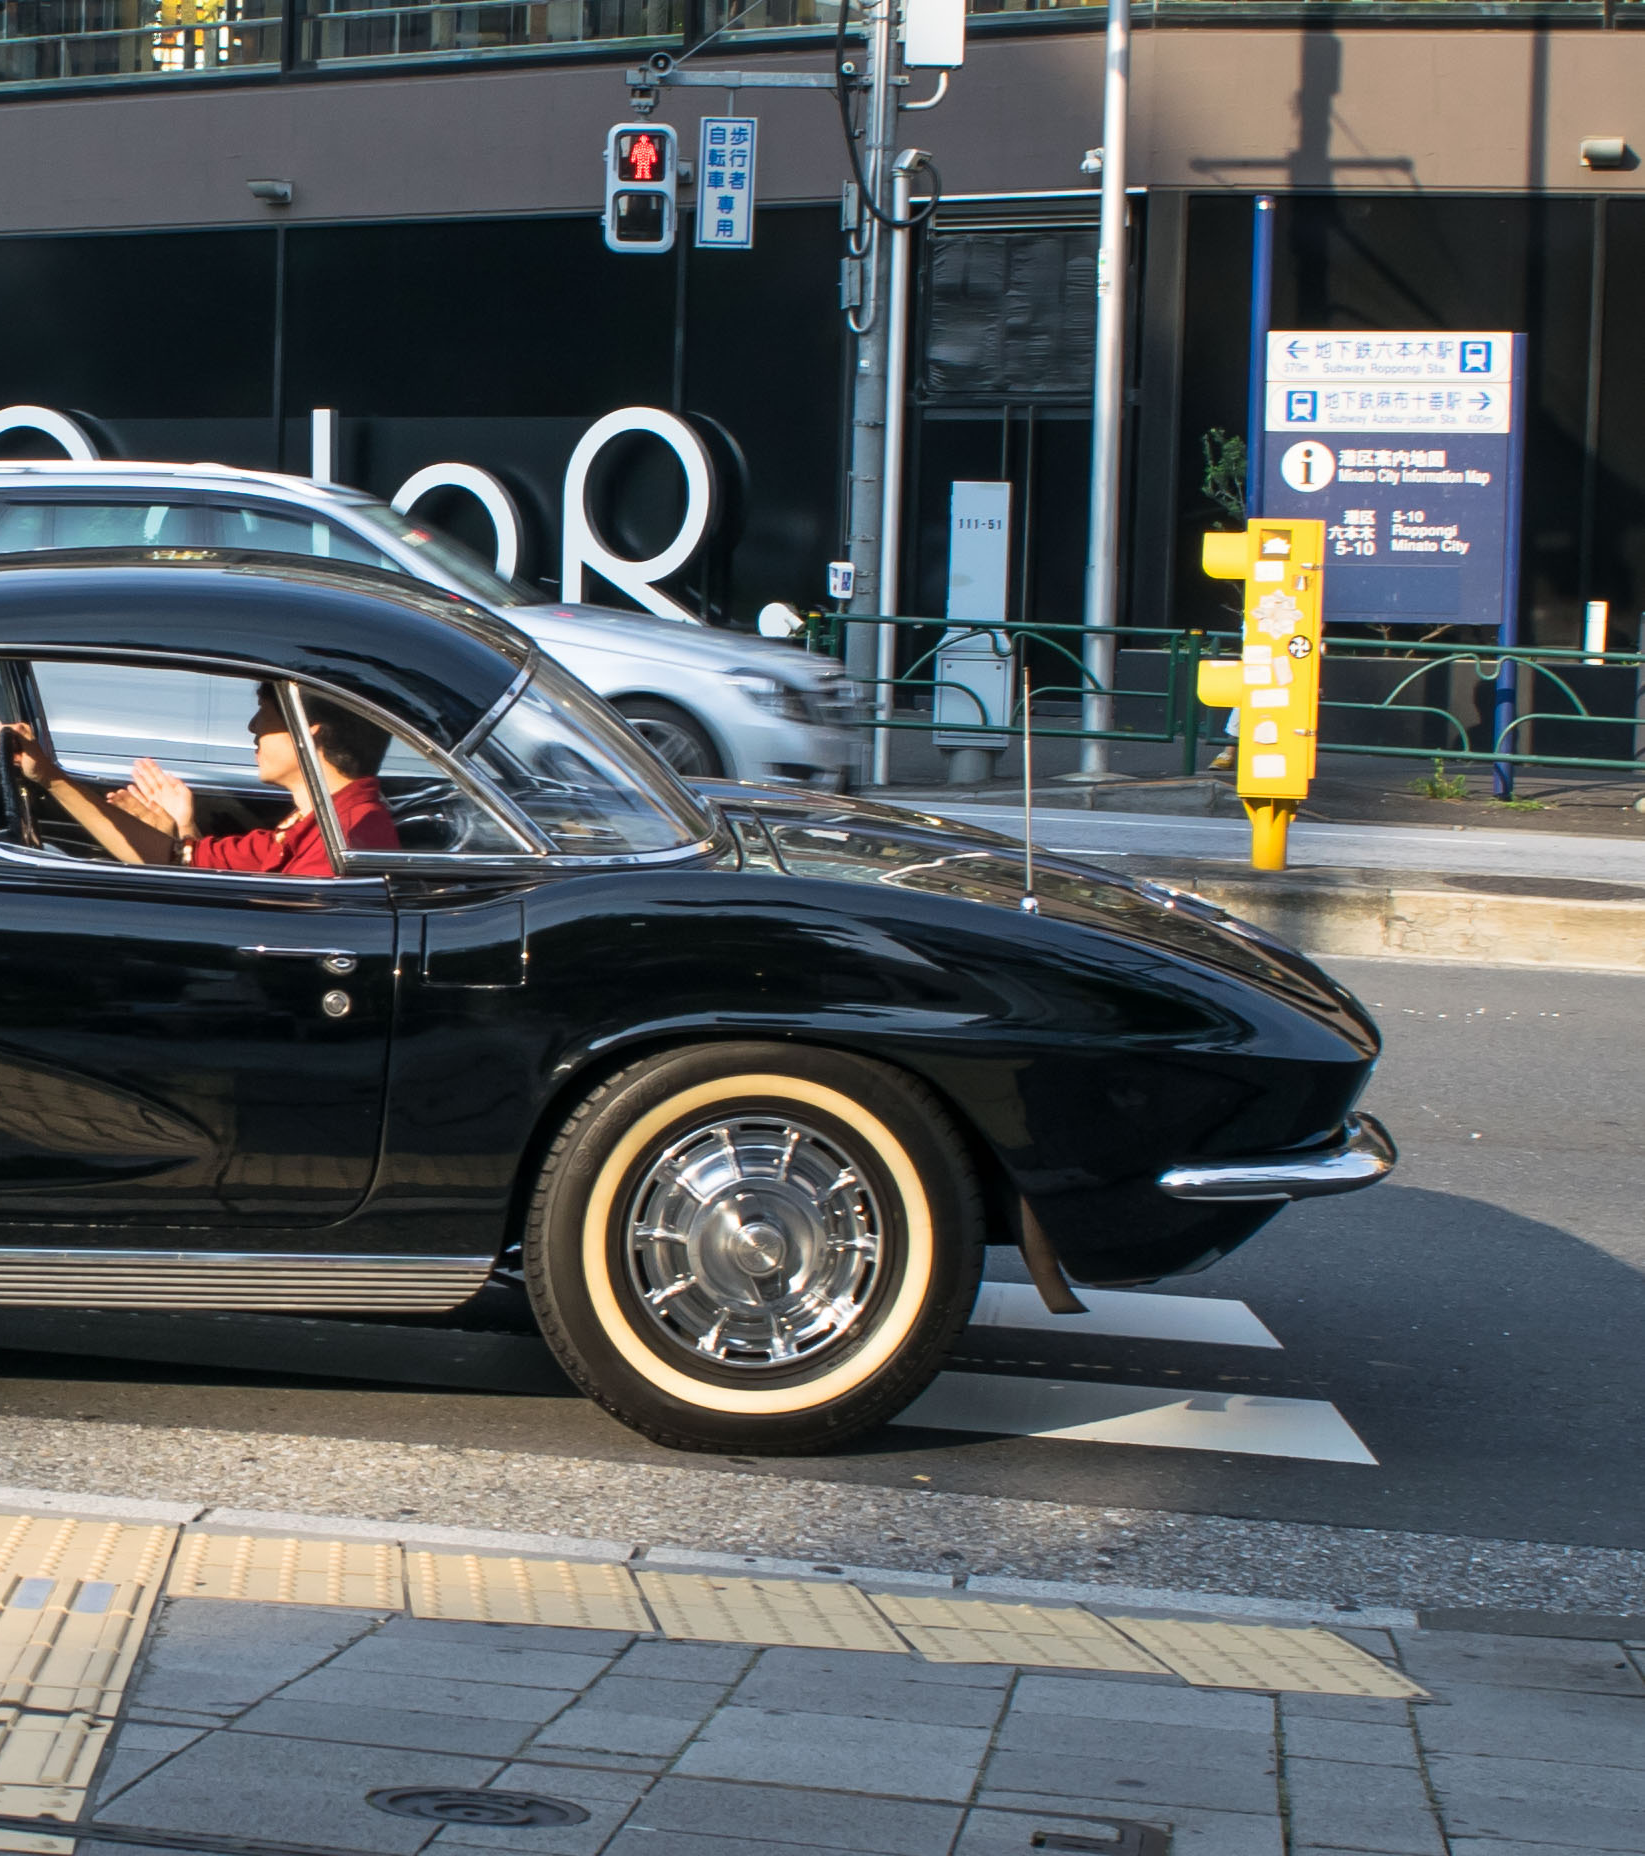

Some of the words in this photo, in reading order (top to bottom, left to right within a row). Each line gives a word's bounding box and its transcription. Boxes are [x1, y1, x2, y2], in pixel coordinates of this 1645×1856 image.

[707, 127, 726, 189] 自転車
[728, 127, 749, 190] 歩行者
[715, 195, 735, 238] 専用
[1315, 340, 1454, 360] 地下鉄六本木駅
[1323, 363, 1366, 375] Subway
[1371, 363, 1422, 375] Roppongi
[1325, 391, 1462, 411] 地下鉄麻布十番駅
[1328, 414, 1367, 425] Subway
[1338, 469, 1376, 483] Minato
[1378, 470, 1400, 485] City
[1403, 470, 1463, 483] Information
[1465, 471, 1491, 486] Map
[958, 518, 1002, 530] 111-51
[1344, 510, 1376, 525] 港区
[1392, 511, 1424, 523] 5-10
[1328, 526, 1375, 540] 六本木
[1391, 525, 1458, 540] Roppongi
[1335, 541, 1375, 556] 5-10
[1391, 539, 1438, 552] Minato
[1441, 540, 1469, 555] City
